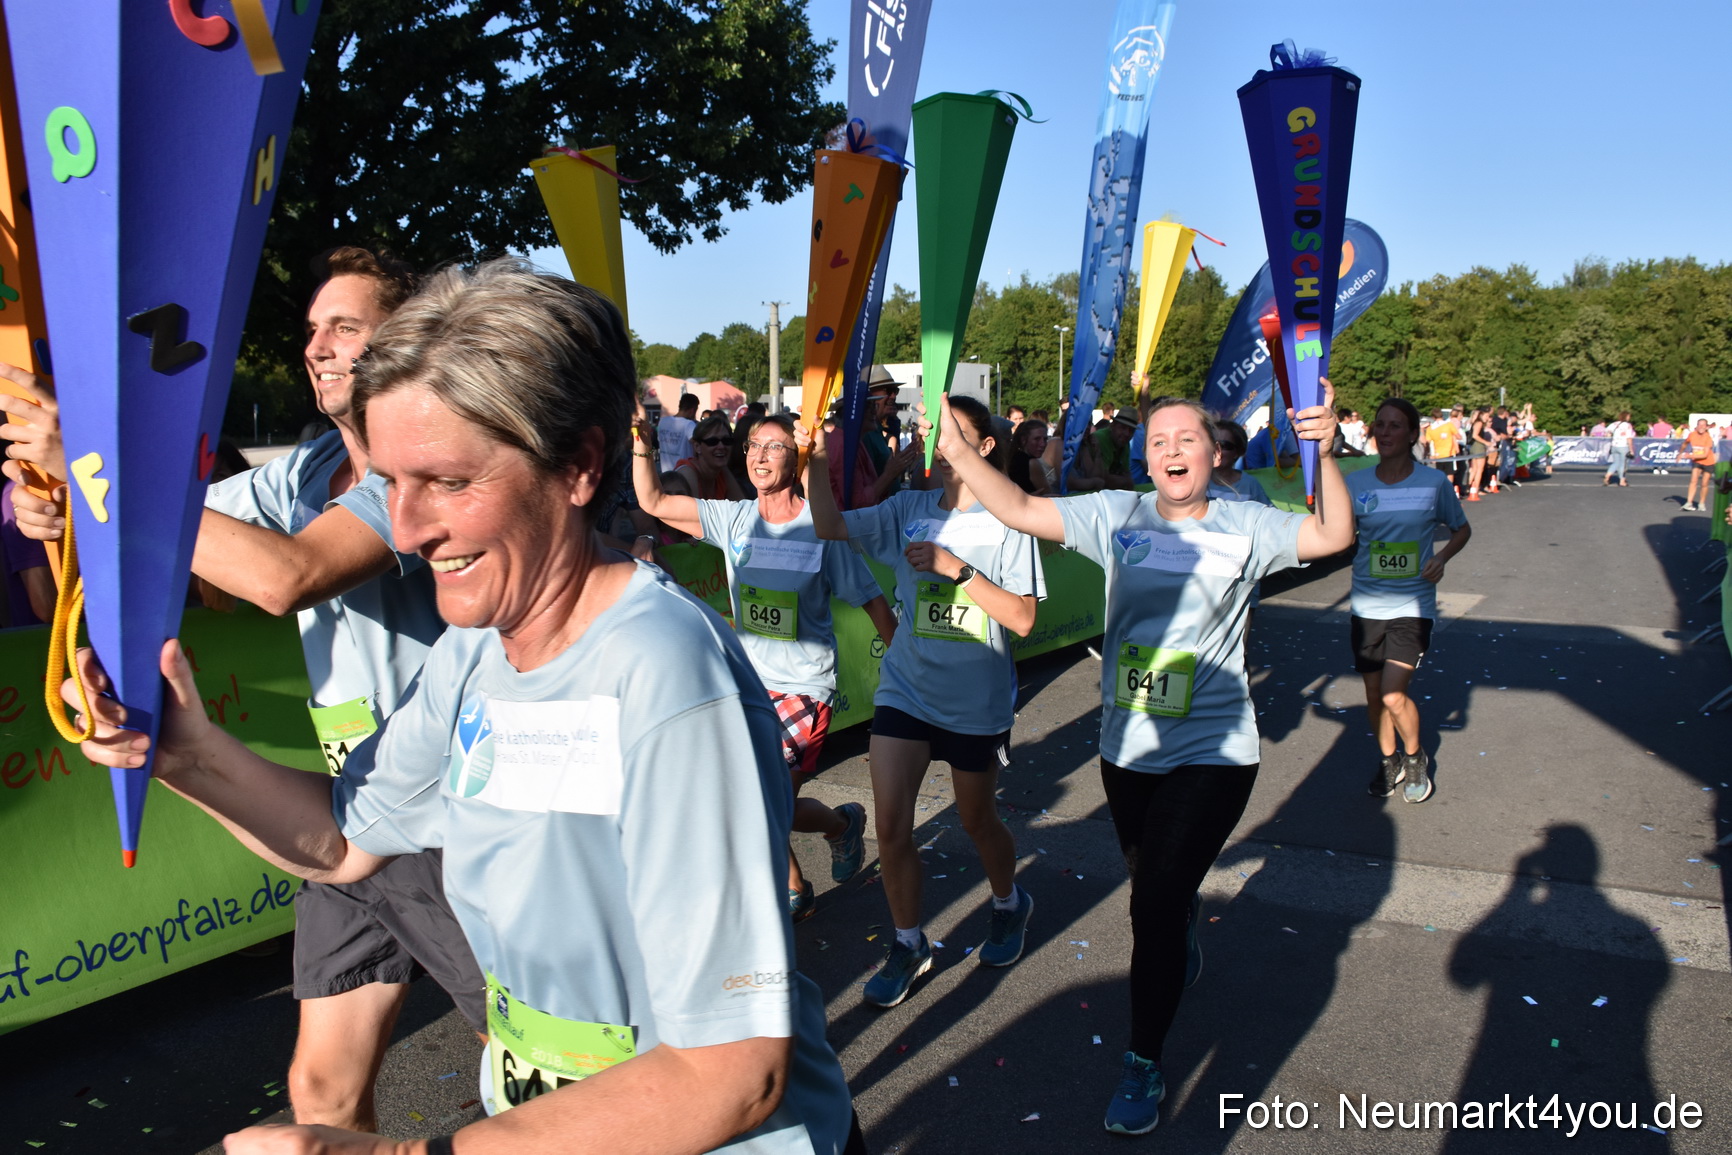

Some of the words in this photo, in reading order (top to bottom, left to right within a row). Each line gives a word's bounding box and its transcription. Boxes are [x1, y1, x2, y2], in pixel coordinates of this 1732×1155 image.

[1286, 106, 1324, 363] GRUNDSCHULE
[1338, 268, 1377, 303] Medien
[1379, 555, 1407, 568] 640
[750, 604, 781, 625] 649
[928, 602, 969, 625] 647
[1127, 668, 1169, 696] 641
[1147, 695, 1165, 704] Maria
